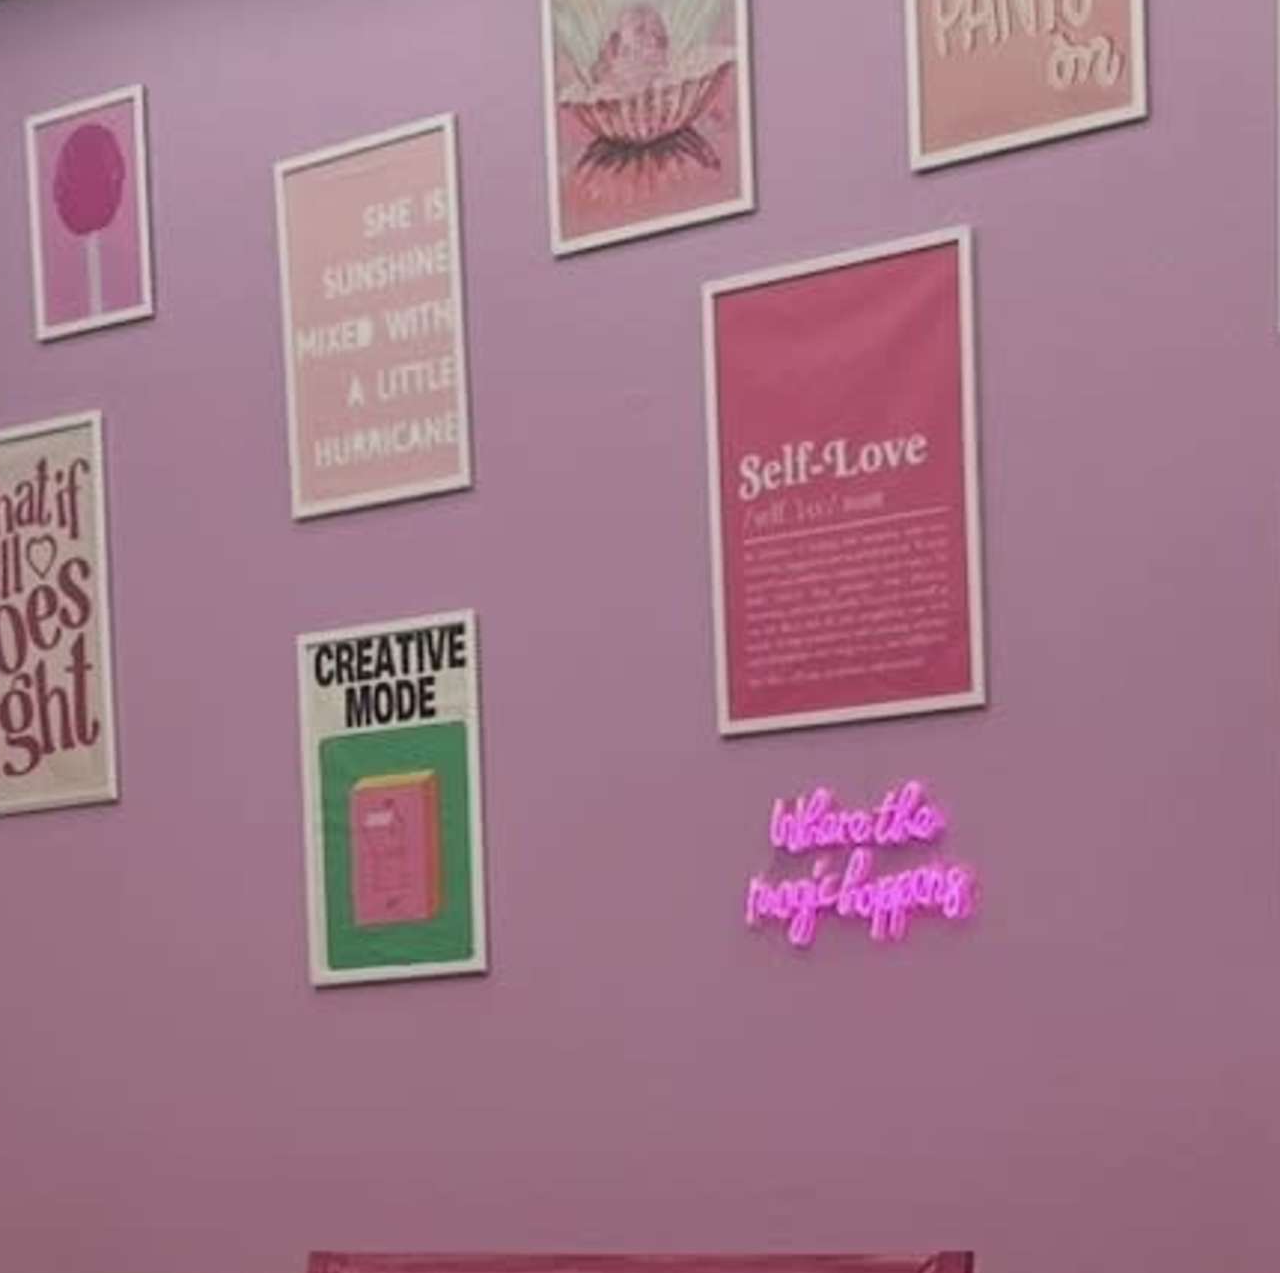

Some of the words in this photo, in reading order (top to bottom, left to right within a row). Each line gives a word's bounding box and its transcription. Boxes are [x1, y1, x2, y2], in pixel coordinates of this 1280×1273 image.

[362, 196, 412, 238] SHE
[424, 186, 447, 222] IS
[322, 238, 450, 300] SUNSHINE
[296, 315, 374, 363] MIXED
[384, 298, 456, 342] WITH
[347, 373, 365, 408] A
[377, 355, 458, 401] LITTLE
[314, 411, 460, 468] HURRICANE
[737, 432, 928, 500] Self-Love
[55, 457, 90, 540] if
[314, 623, 467, 687] CREATIVE
[345, 675, 436, 728] MODE
